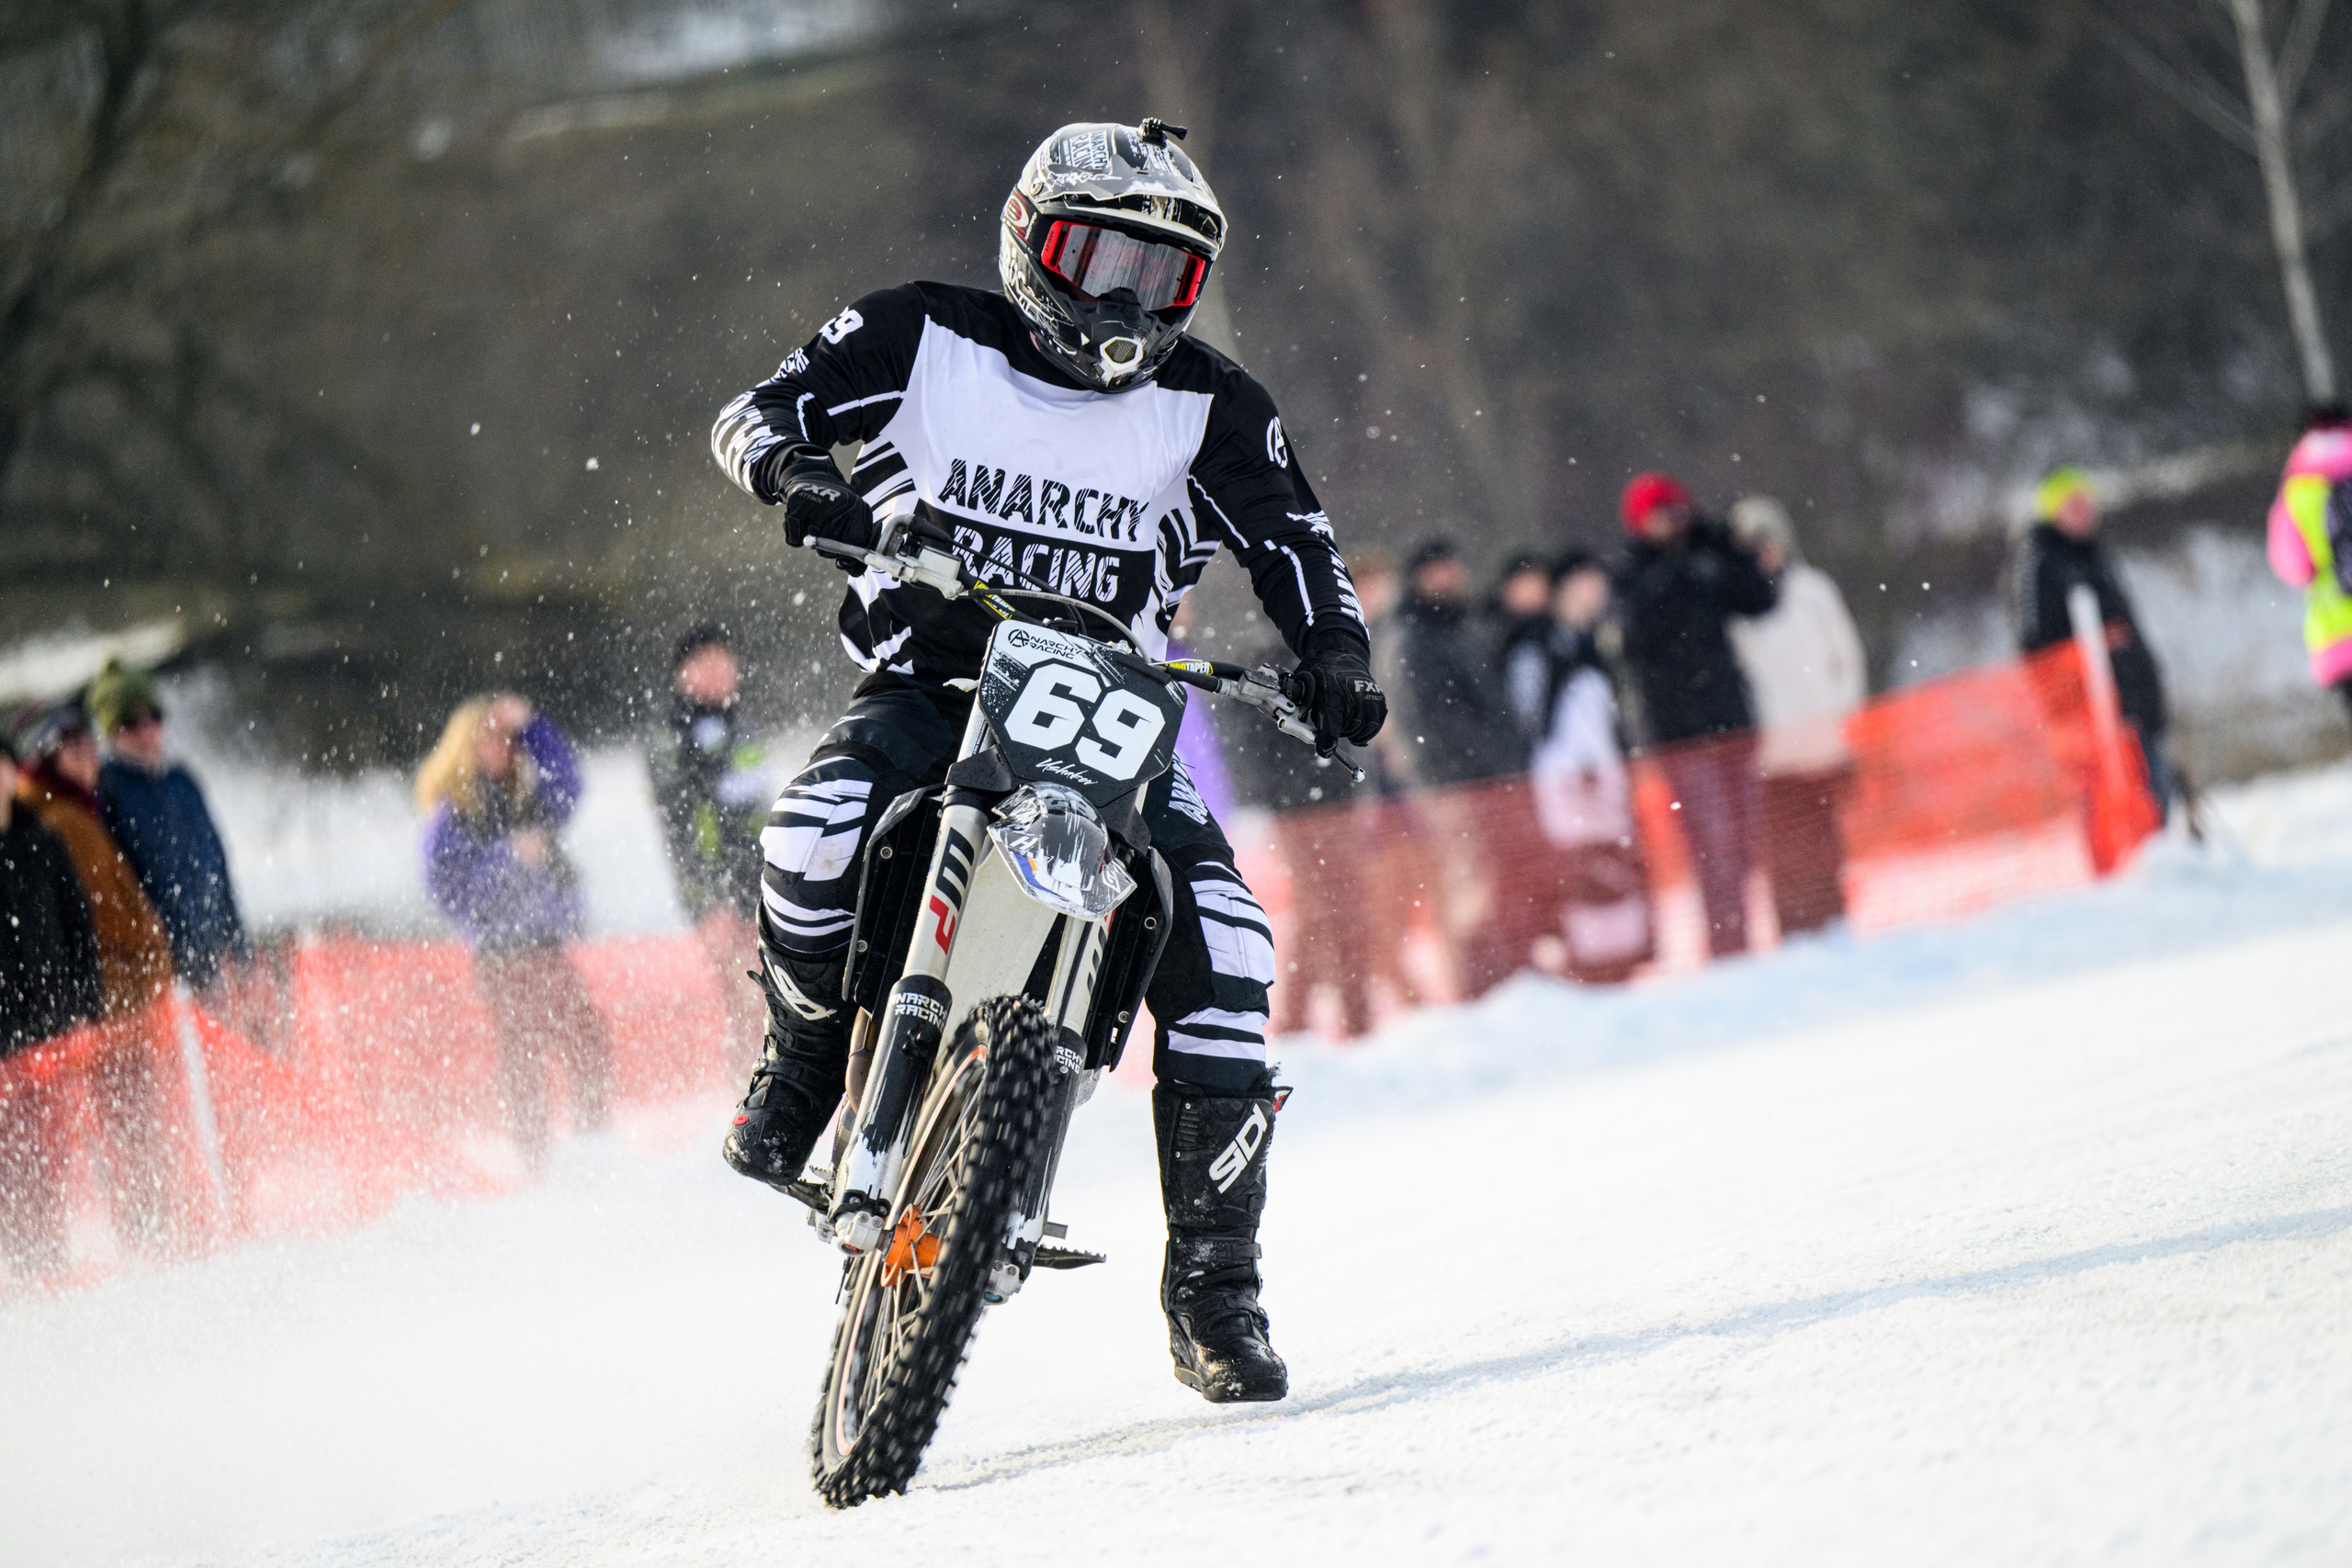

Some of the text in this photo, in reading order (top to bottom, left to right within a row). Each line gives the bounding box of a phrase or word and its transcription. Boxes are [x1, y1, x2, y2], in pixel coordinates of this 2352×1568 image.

[938, 458, 1149, 542] ANARCHY
[952, 525, 1120, 602] RACING
[1030, 642, 1075, 660] RACING
[1004, 663, 1166, 781] 69
